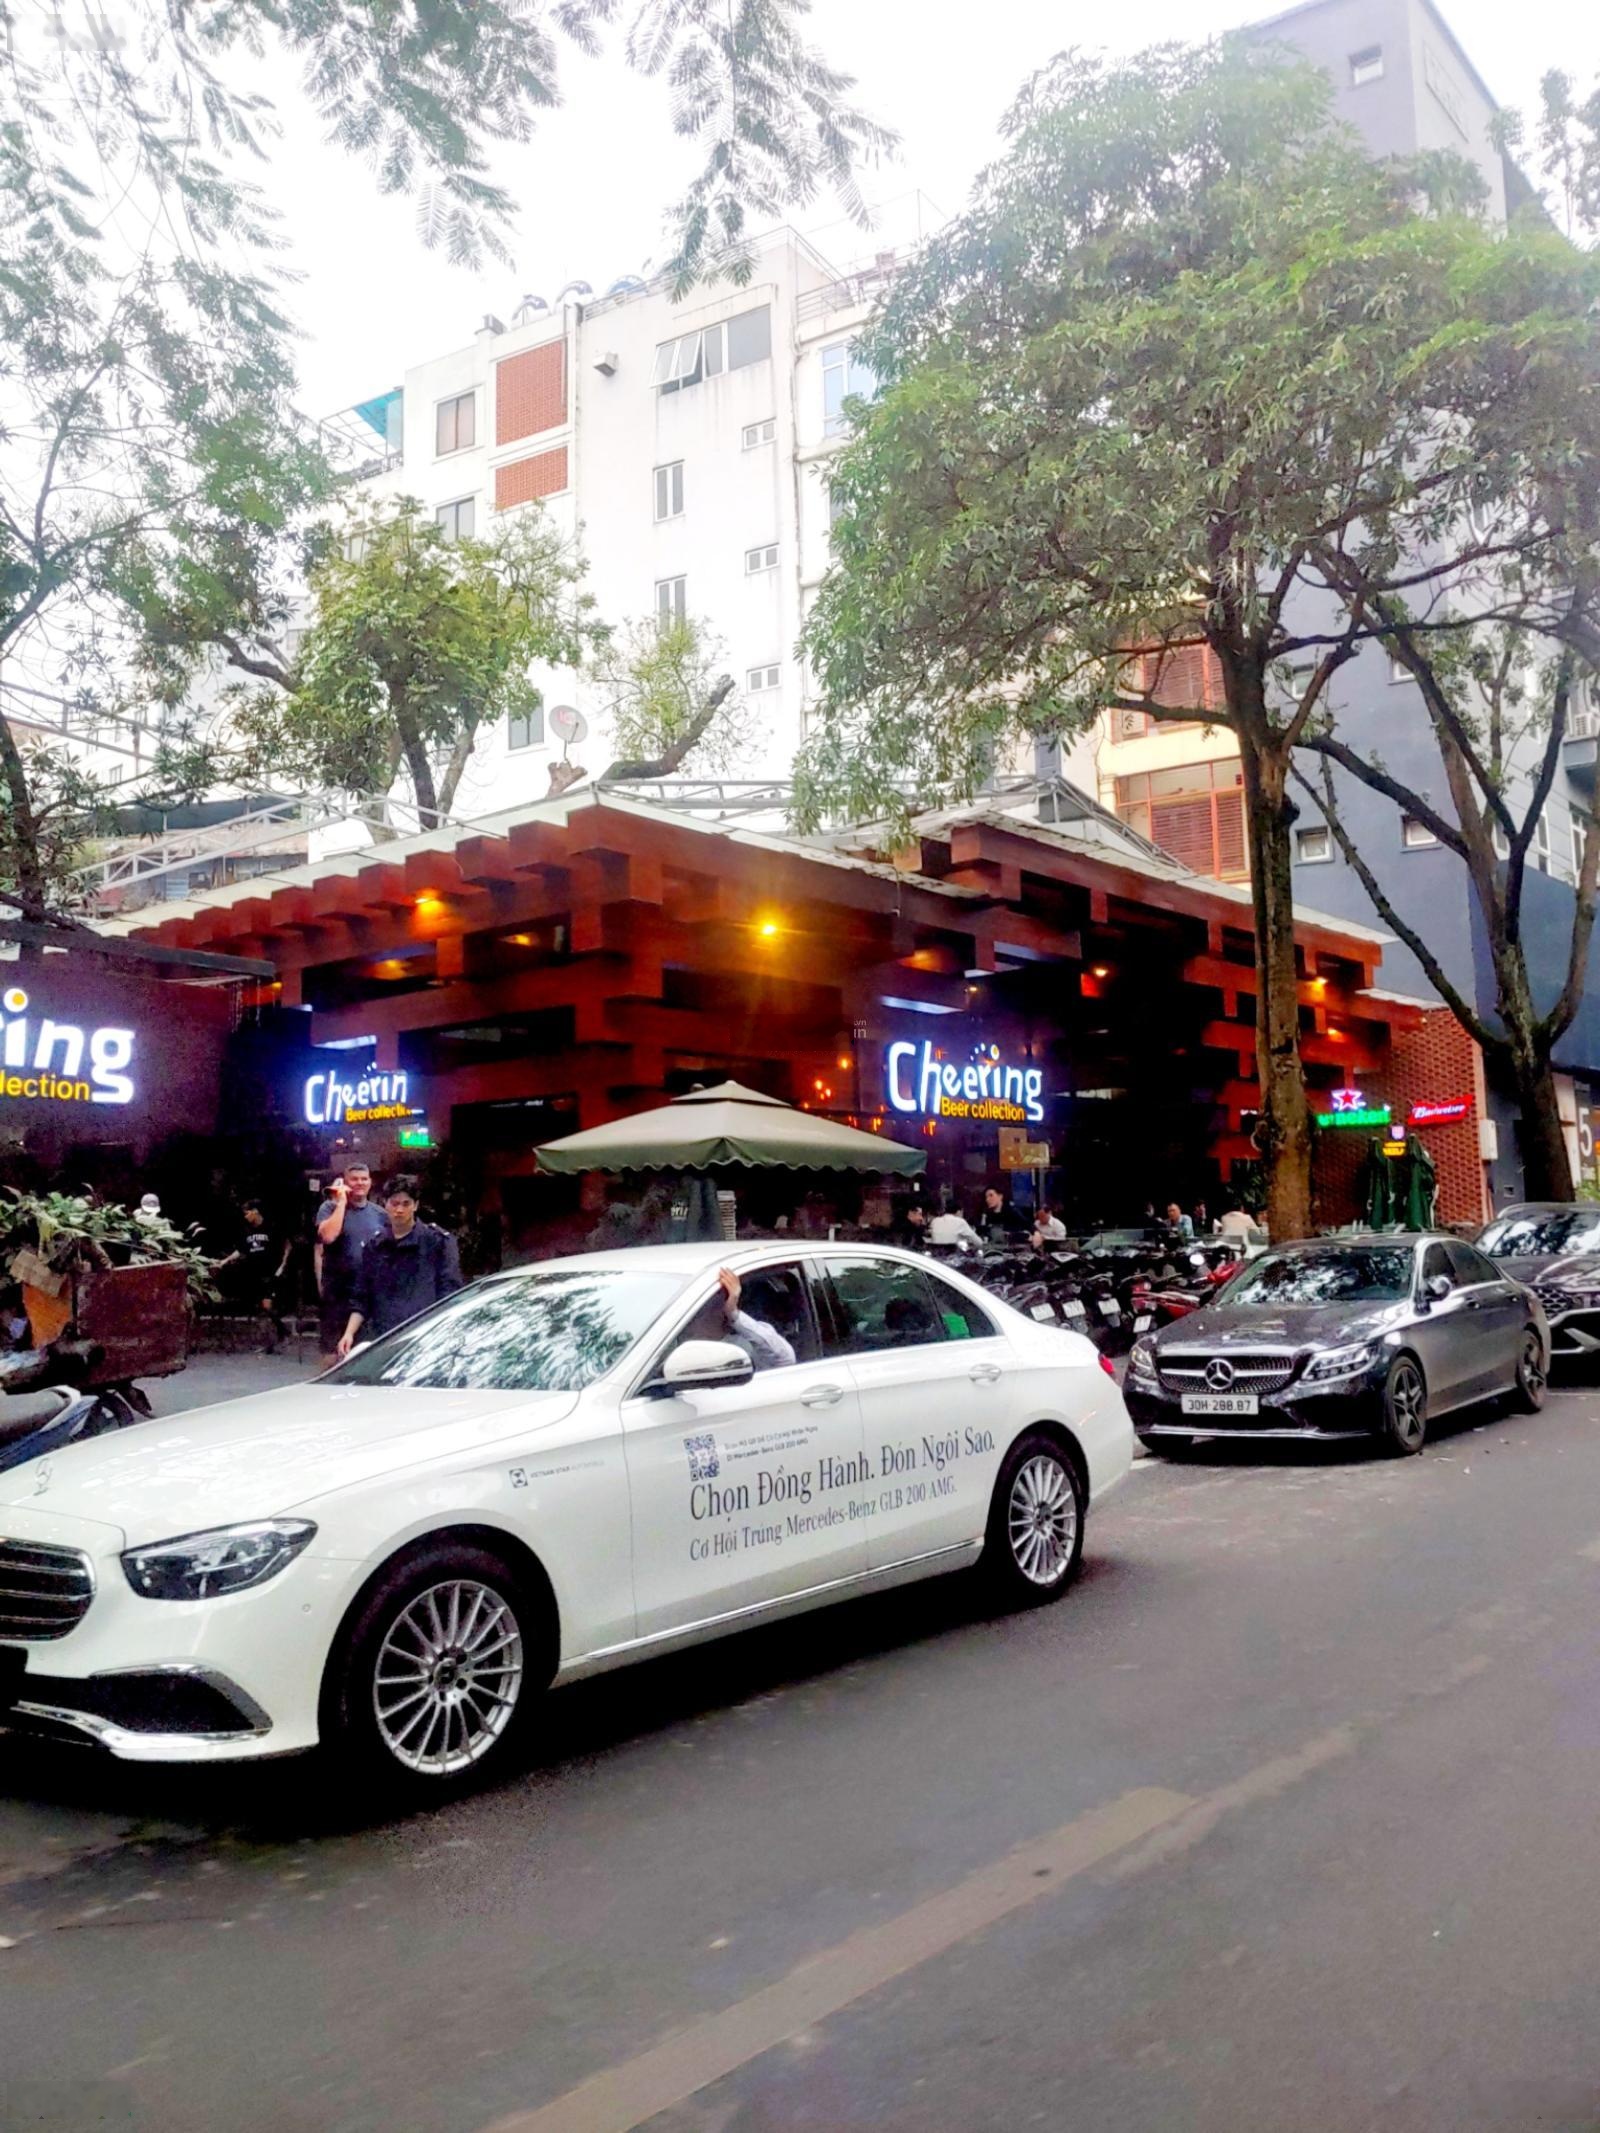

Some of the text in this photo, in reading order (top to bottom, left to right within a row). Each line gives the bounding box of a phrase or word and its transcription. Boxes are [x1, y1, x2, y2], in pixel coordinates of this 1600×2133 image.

[0, 988, 136, 1104] ing
[305, 1069, 411, 1124] Cheerin
[889, 1040, 1044, 1121] Cheering
[941, 1096, 1025, 1121] Beer collection
[690, 1482, 750, 1522] Chọn
[757, 1465, 812, 1504] Đồng
[881, 1442, 916, 1476] Đón
[922, 1430, 959, 1471] Ngôi
[965, 1426, 995, 1456] Sao.
[787, 1498, 877, 1537] Mercedes-Benz
[880, 1488, 902, 1511] GLB
[906, 1482, 926, 1505] 200
